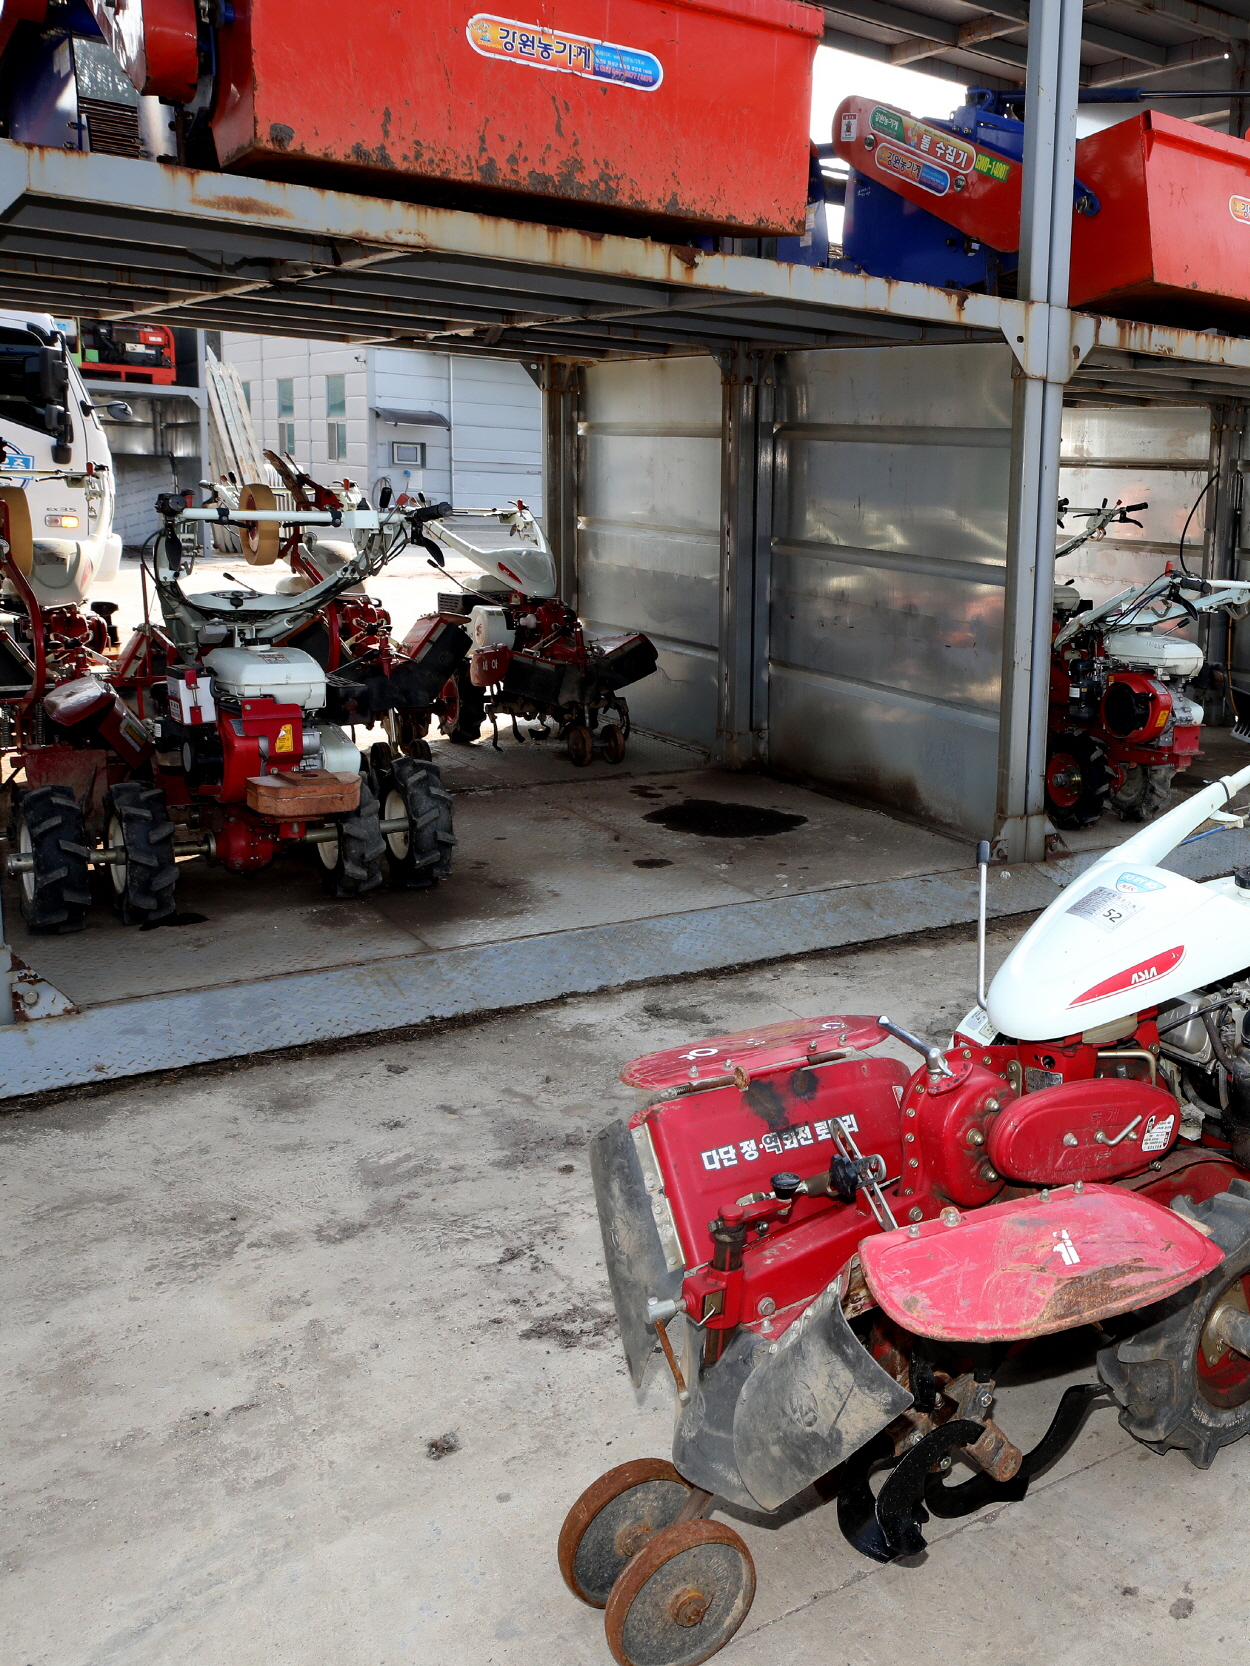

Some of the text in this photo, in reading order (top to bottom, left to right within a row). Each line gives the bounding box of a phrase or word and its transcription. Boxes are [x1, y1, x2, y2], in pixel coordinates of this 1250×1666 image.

[499, 27, 591, 70] 강원농기계
[887, 151, 921, 180] 강원농기계
[935, 141, 968, 169] 수집기
[1102, 907, 1123, 923] 52
[1131, 966, 1158, 985] ASIA
[701, 1145, 739, 1171] 다단
[814, 1113, 860, 1142] 로리
